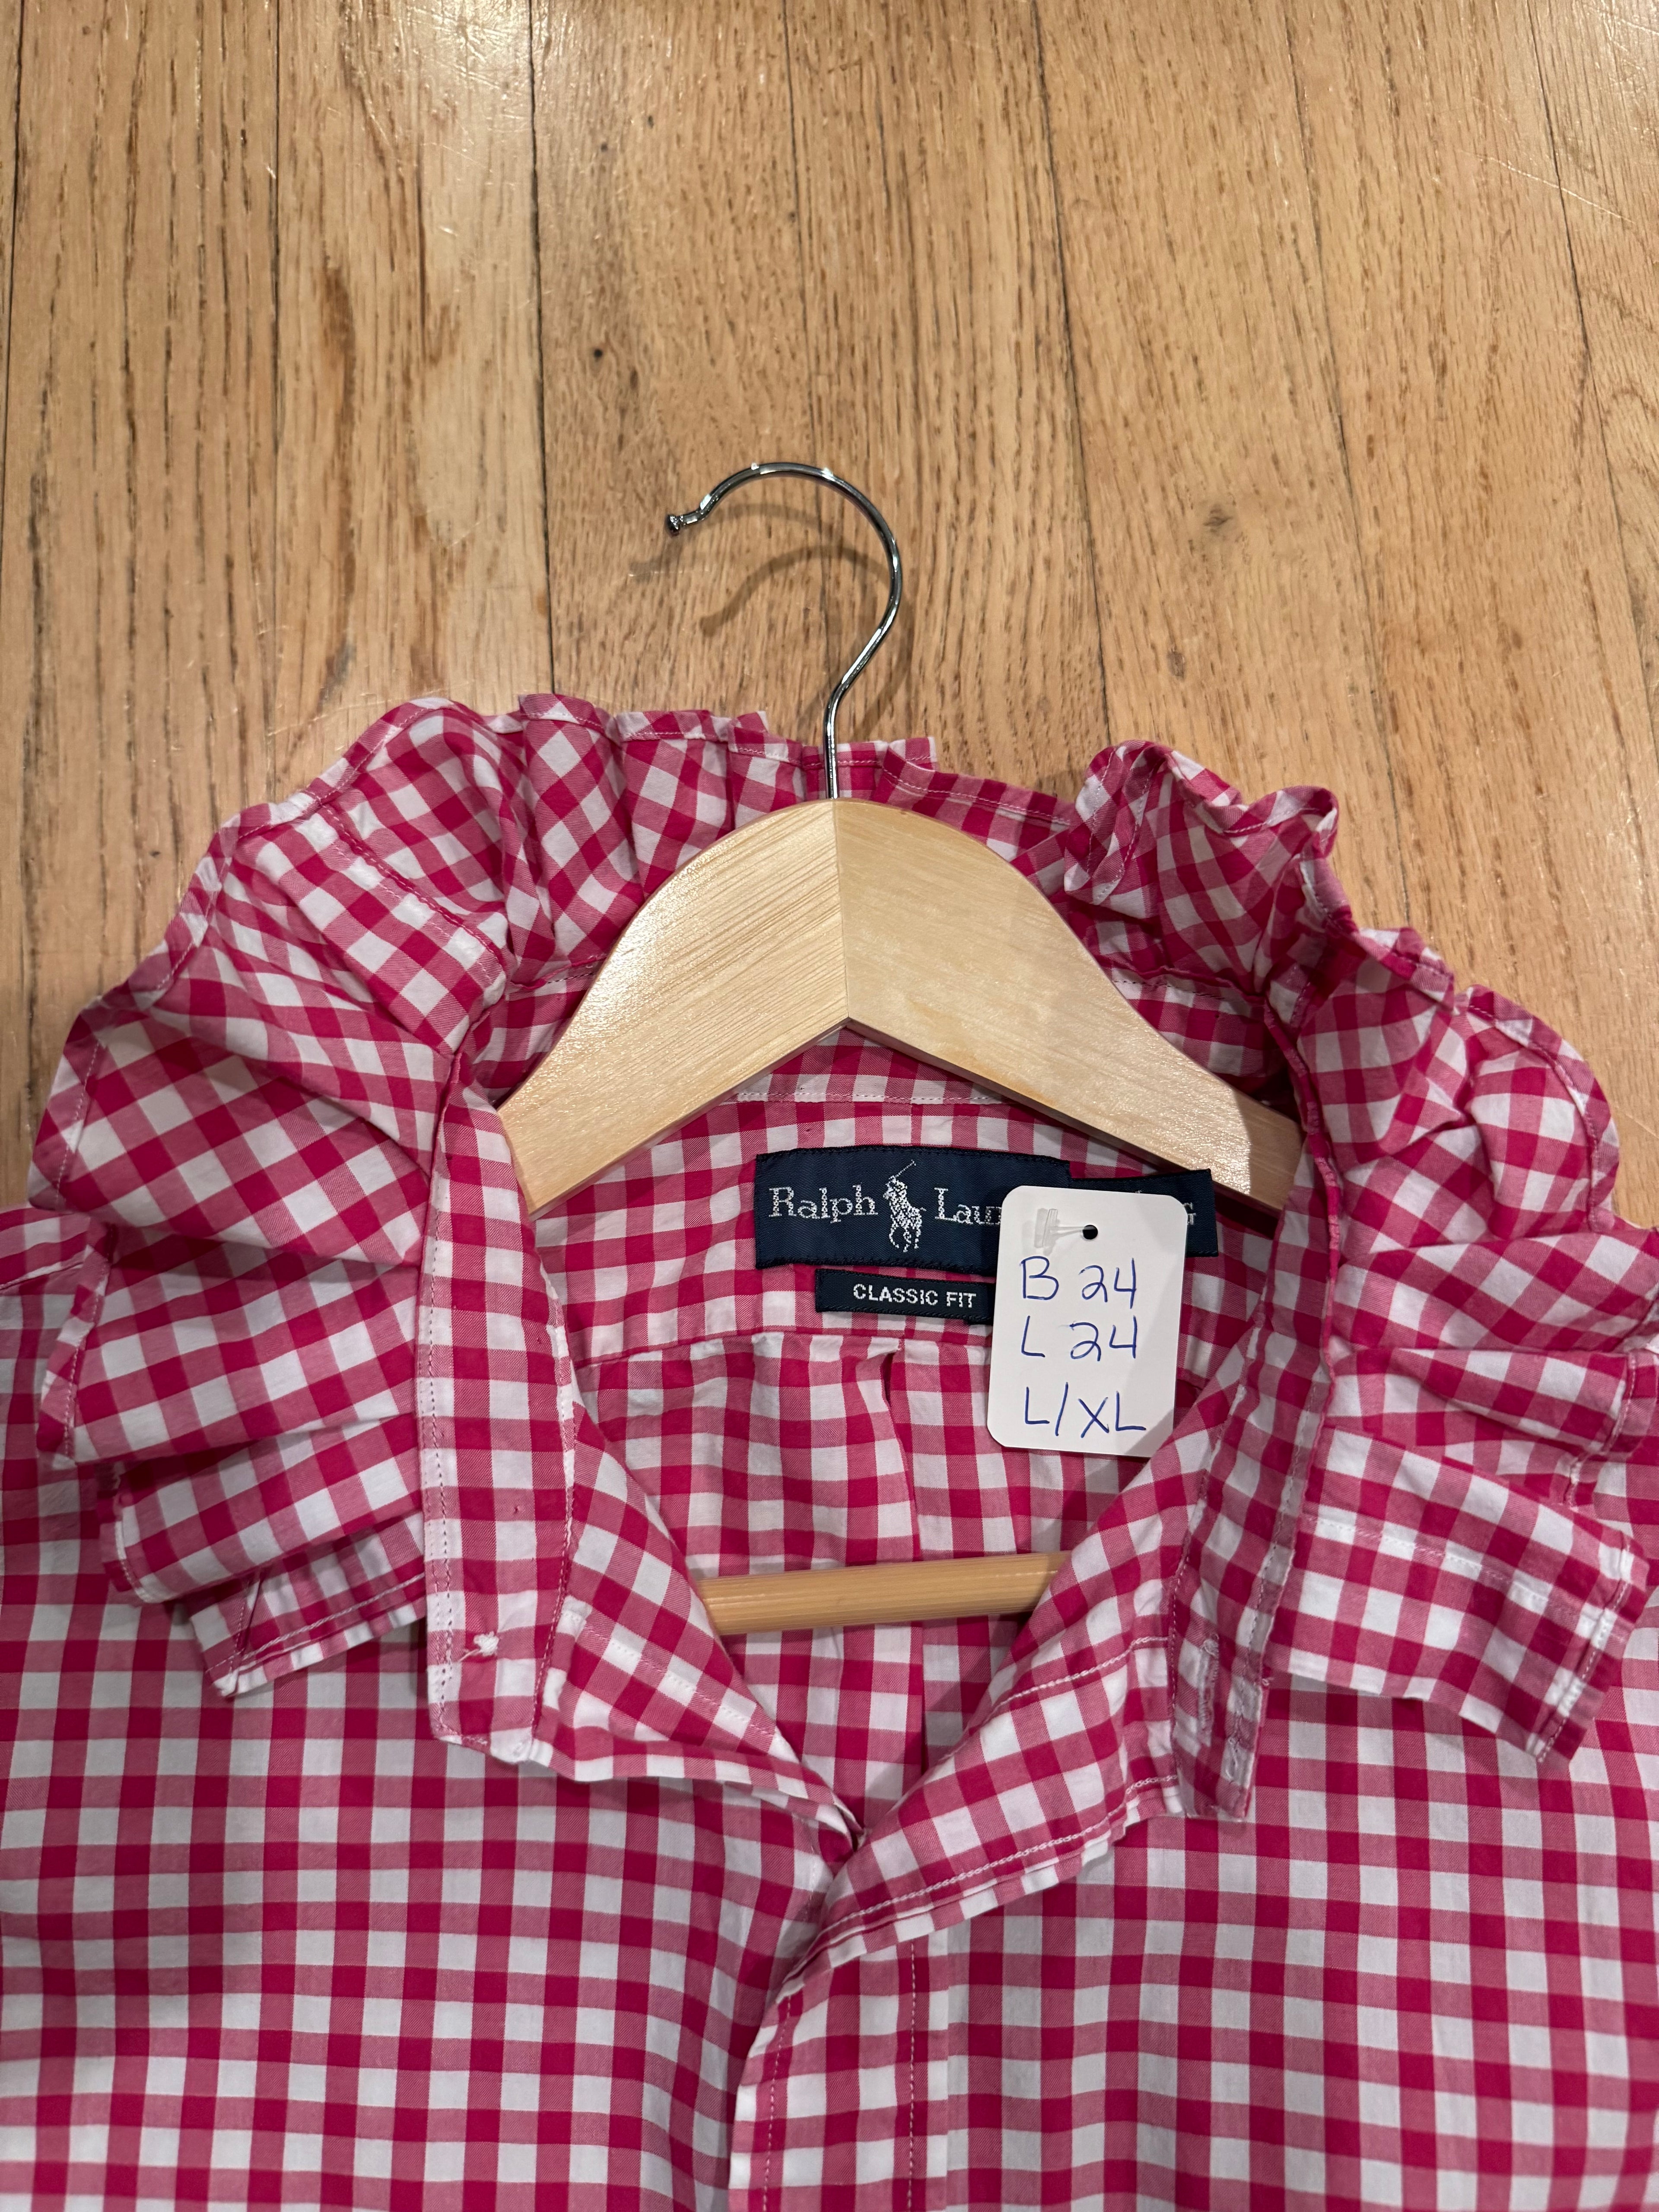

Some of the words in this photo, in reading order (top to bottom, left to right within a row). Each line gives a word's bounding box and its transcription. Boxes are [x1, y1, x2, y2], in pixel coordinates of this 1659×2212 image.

[768, 1184, 878, 1224] Ralph
[853, 1284, 938, 1306] CLASSIC
[946, 1291, 976, 1308] FIT
[1020, 1255, 1059, 1301] B
[1079, 1258, 1137, 1309] 24
[1021, 1315, 1046, 1357] L
[1069, 1315, 1137, 1361] 24
[1025, 1382, 1147, 1438] L/XL
